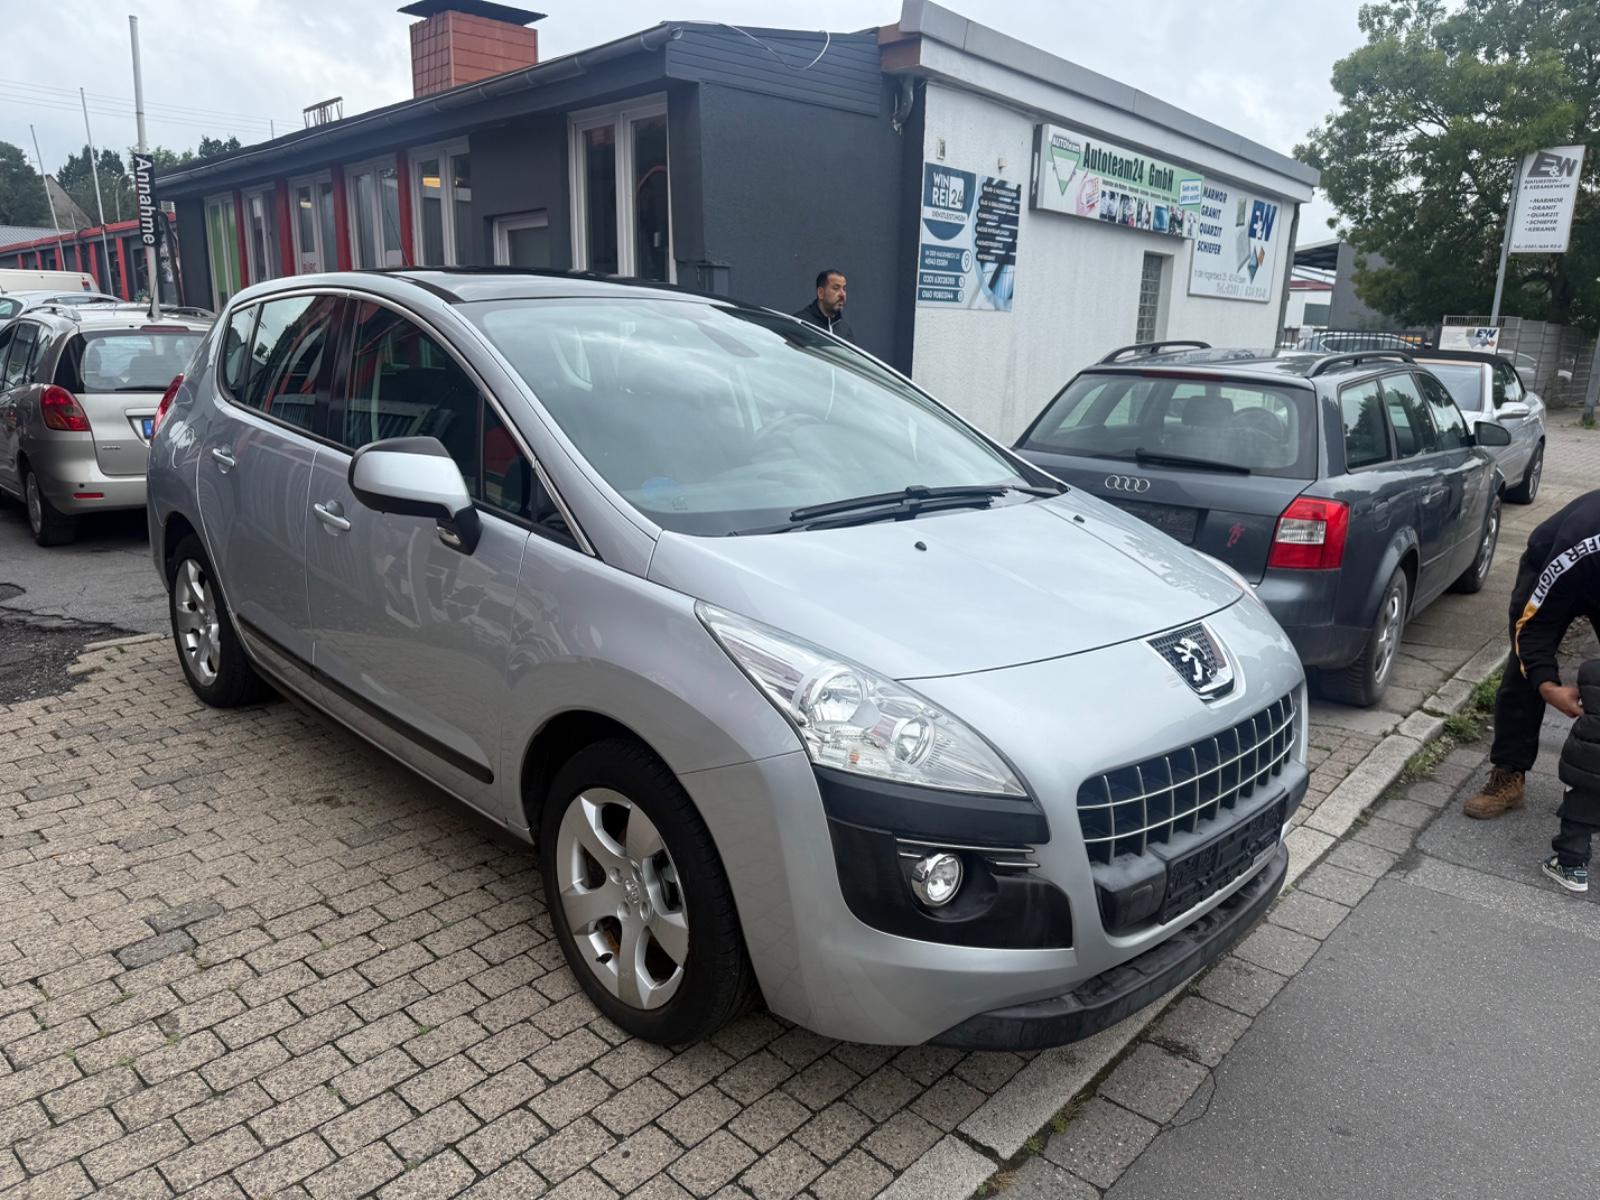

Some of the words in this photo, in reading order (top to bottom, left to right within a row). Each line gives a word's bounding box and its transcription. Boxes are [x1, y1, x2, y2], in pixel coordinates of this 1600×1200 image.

[1083, 142, 1144, 184] Autoteam24
[1149, 163, 1174, 192] GmbH
[1527, 150, 1579, 177] E&W
[933, 172, 950, 188] WIN
[135, 156, 156, 245] Annahme
[932, 187, 949, 206] REI
[1202, 186, 1227, 204] MARMOR
[1201, 205, 1221, 220] GRANIT
[1248, 200, 1278, 242] E&W
[1199, 222, 1222, 238] QUARZIT
[1197, 240, 1221, 255] SCHIEFER
[1565, 535, 1600, 563] FER
